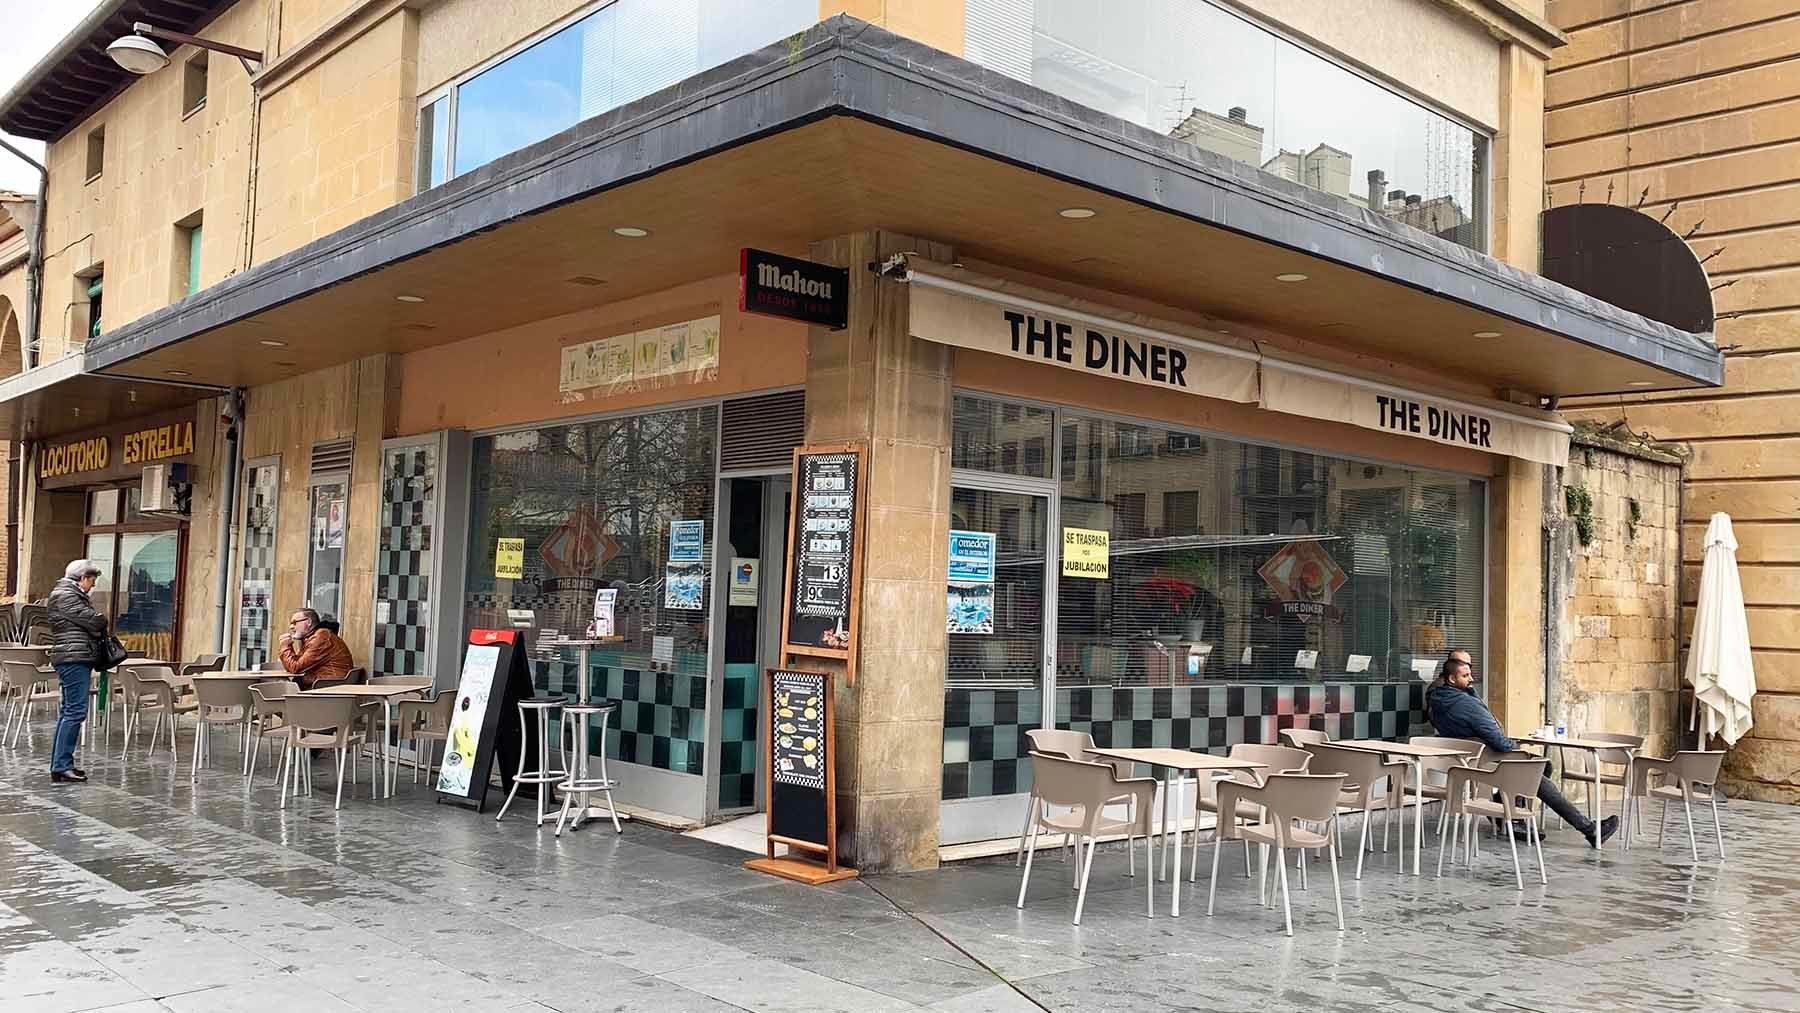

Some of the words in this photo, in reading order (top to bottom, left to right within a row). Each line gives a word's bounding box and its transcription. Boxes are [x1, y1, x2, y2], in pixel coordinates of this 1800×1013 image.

[758, 262, 832, 300] Mahou
[1004, 310, 1072, 364] THE
[1085, 329, 1187, 387] DINER
[1376, 395, 1421, 433] THE
[1427, 406, 1491, 448] DINER
[40, 436, 108, 478] LOCUTORIO
[123, 421, 194, 465] ESTRELLA
[1066, 532, 1075, 544] SE
[1076, 533, 1107, 547] TRASPASA
[1065, 560, 1107, 573] JUBILACIÓN
[1283, 602, 1299, 613] THE
[1300, 602, 1324, 614] DINER
